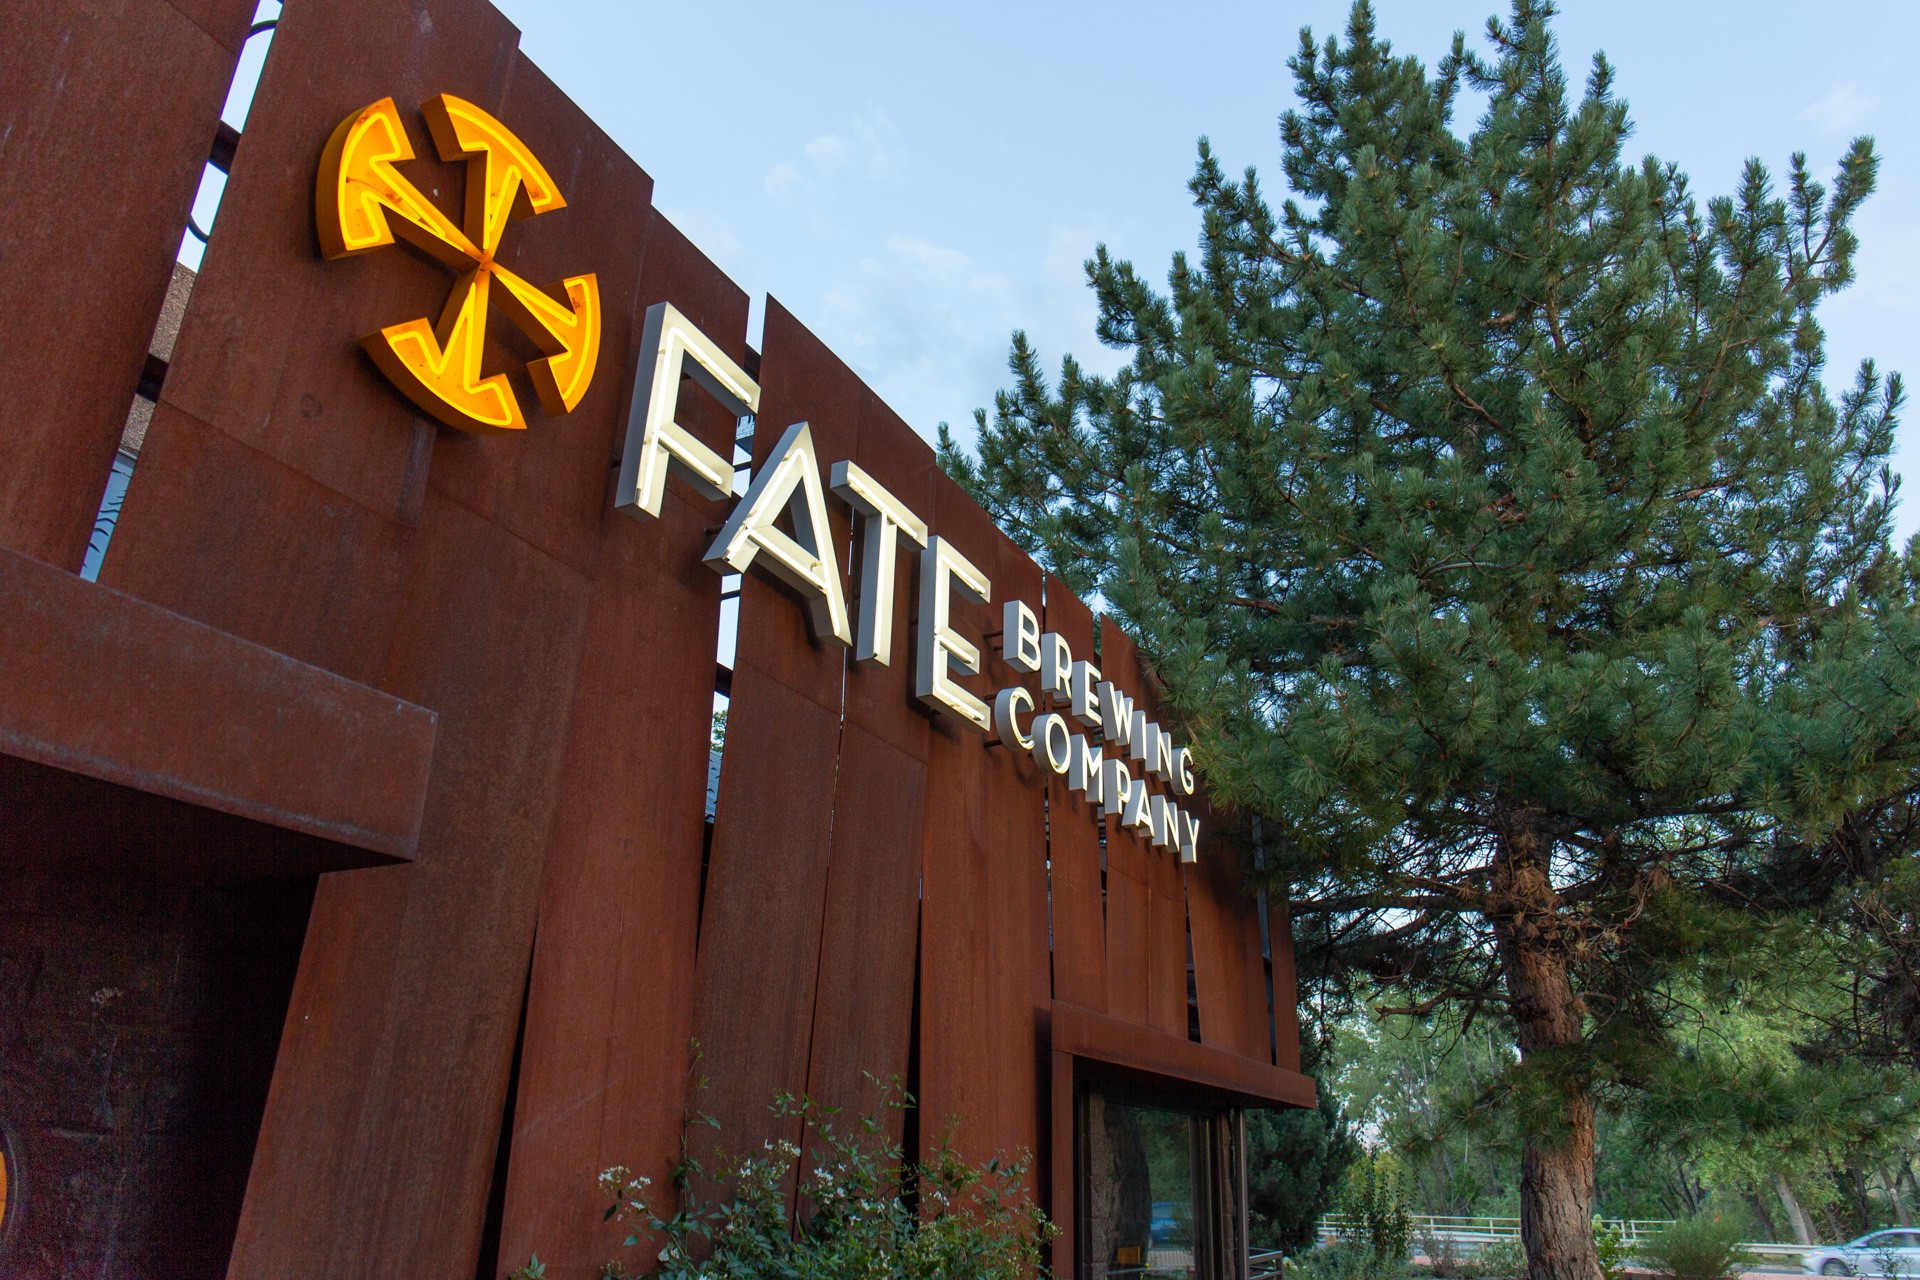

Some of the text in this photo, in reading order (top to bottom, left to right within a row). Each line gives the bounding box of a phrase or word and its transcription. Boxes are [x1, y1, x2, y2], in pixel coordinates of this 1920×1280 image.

[615, 301, 991, 731] FATE
[995, 686, 1199, 863] COMPANY
[1003, 600, 1194, 795] BREWING
